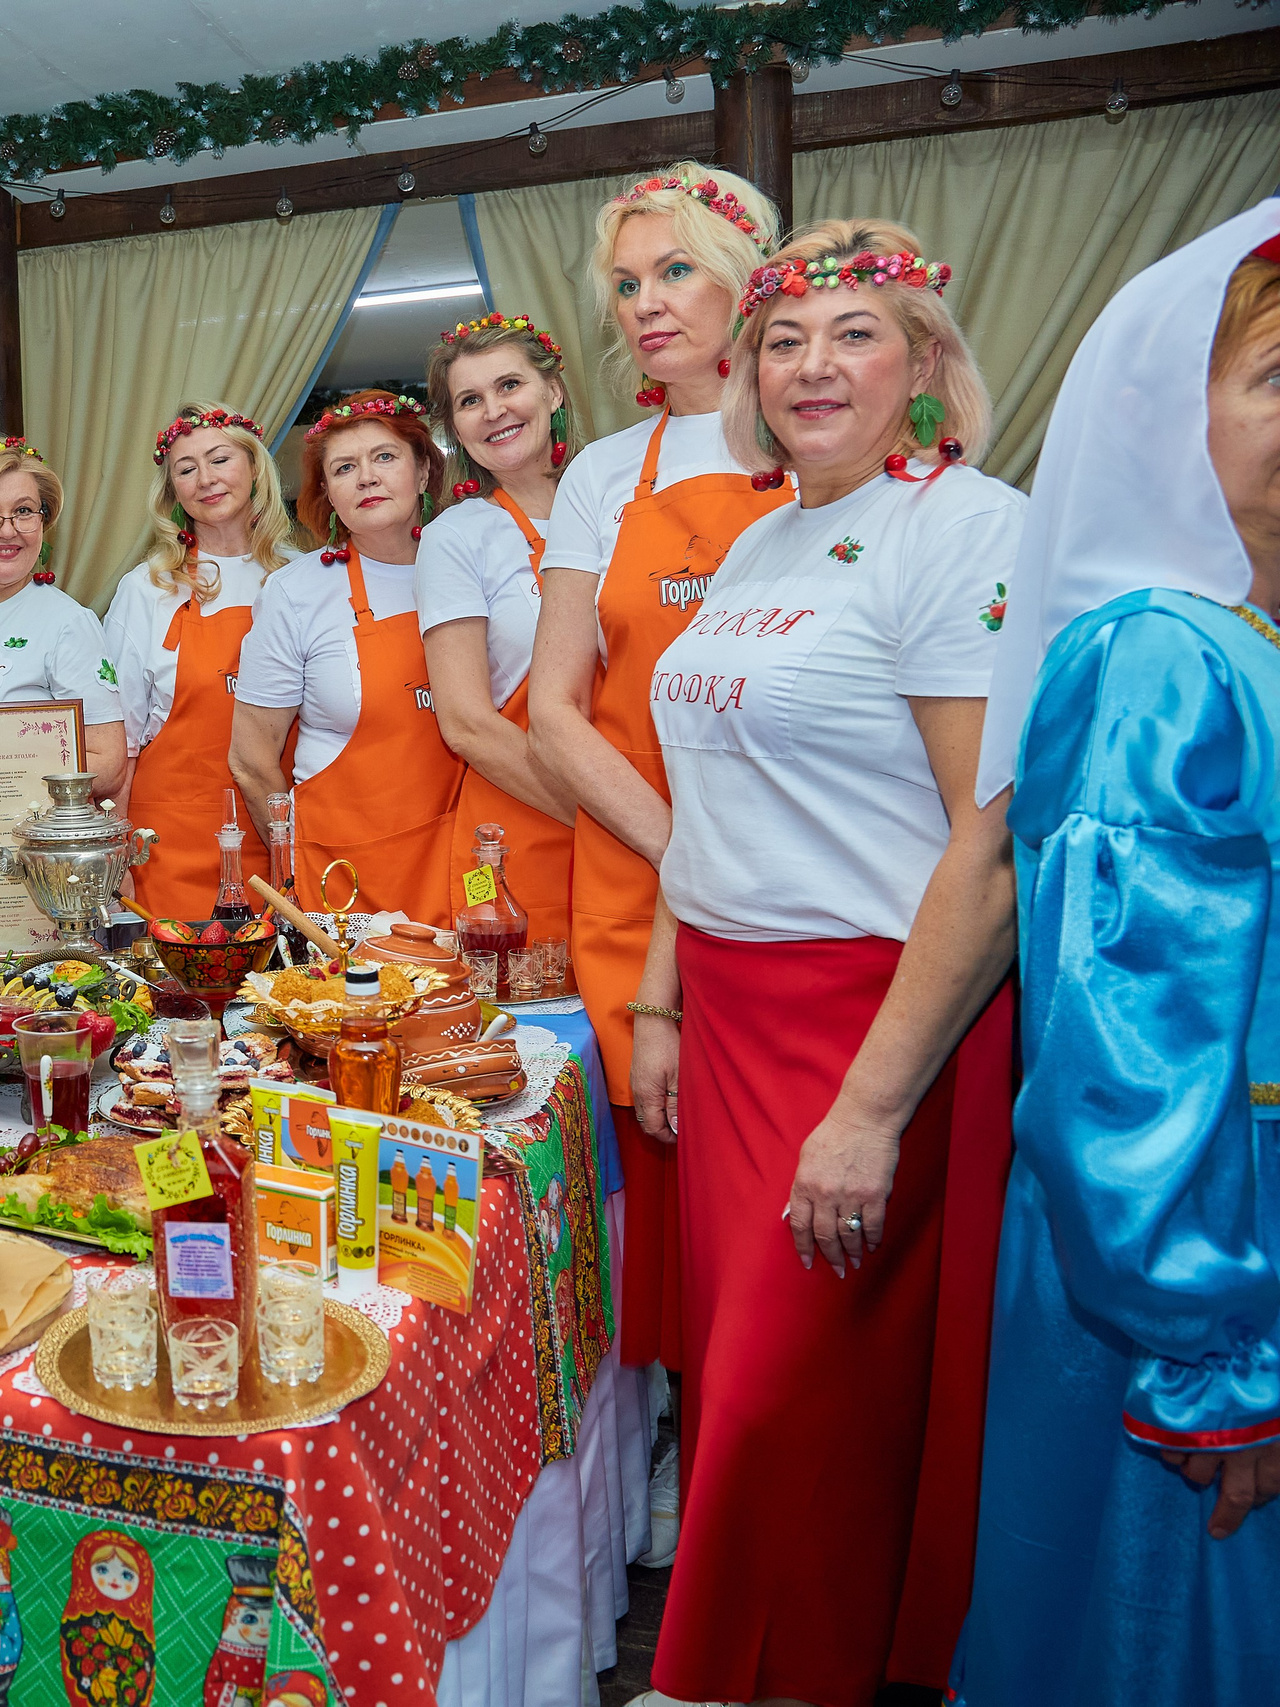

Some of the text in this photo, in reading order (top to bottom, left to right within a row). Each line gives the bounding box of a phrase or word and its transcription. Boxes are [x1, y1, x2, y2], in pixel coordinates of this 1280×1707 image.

[650, 671, 747, 714] ГОДКА
[337, 1164, 363, 1240] Горлинка
[265, 1221, 313, 1248] Горлинка
